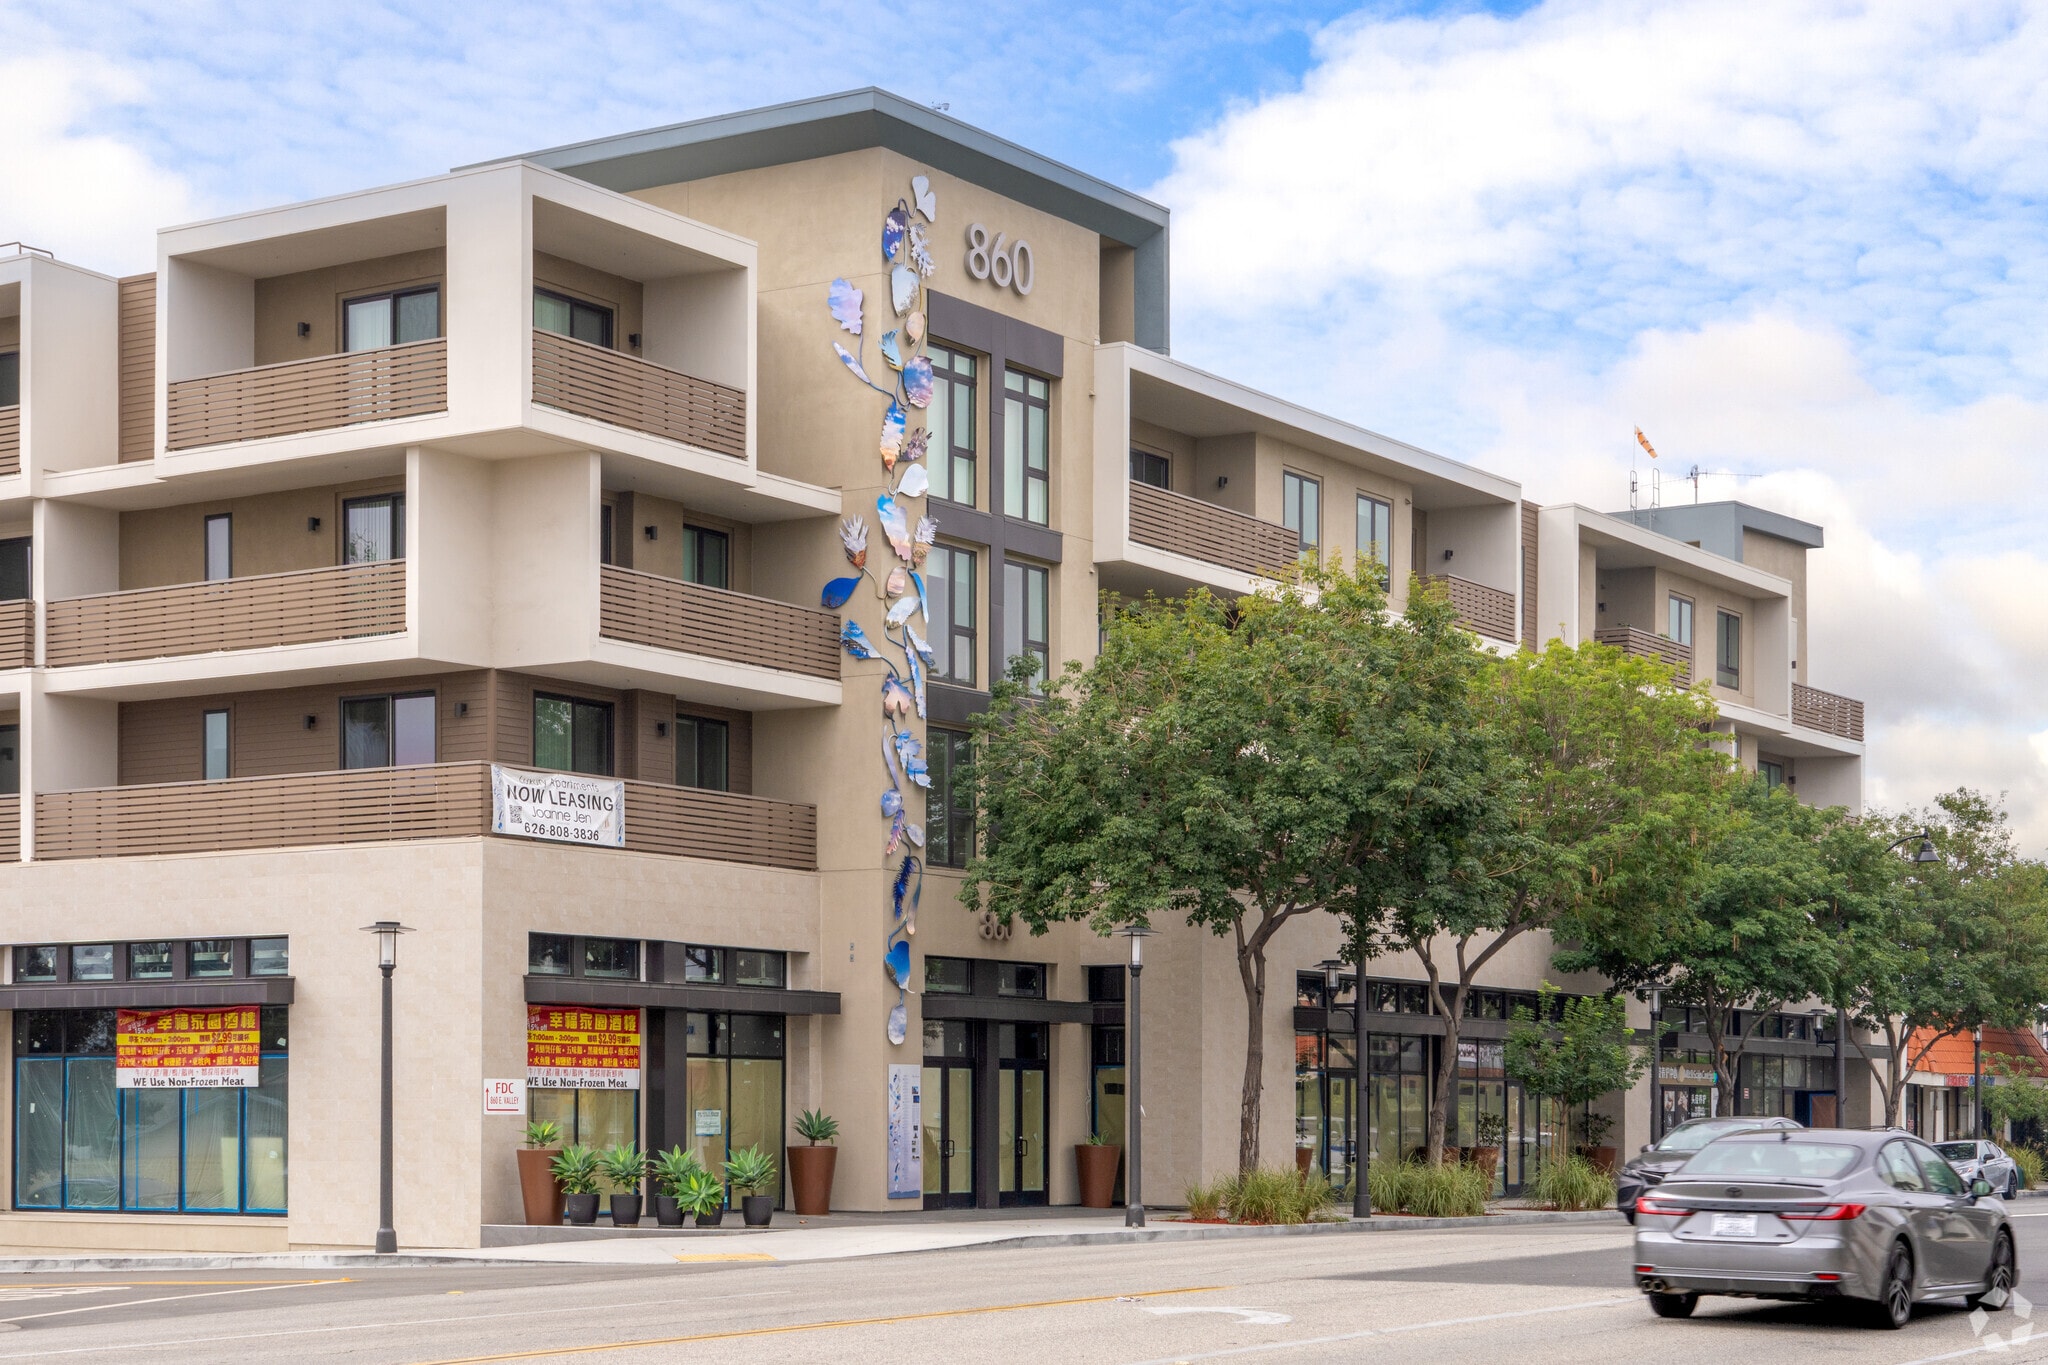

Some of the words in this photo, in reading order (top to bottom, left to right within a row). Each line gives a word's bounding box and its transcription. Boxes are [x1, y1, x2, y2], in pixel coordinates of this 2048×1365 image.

[964, 223, 1035, 297] 860
[550, 778, 599, 792] Apartments
[507, 785, 545, 804] NOW
[549, 790, 614, 812] LEASING
[532, 806, 571, 822] Joanne
[574, 810, 592, 824] Jen
[524, 822, 599, 841] 626-808-3836
[140, 1036, 162, 1044] 7:00am
[211, 1032, 232, 1044] $2.99
[533, 1033, 554, 1041] 7:00am
[559, 1034, 580, 1042] 3:00pm
[598, 1033, 617, 1045] $2.99
[133, 1077, 147, 1087] WE
[150, 1077, 165, 1087] Use
[168, 1077, 218, 1087] Non-Frozen
[221, 1077, 245, 1086] Meat
[495, 1082, 514, 1094] FDC
[542, 1077, 557, 1087] Use
[560, 1077, 605, 1088] Non-Frozen
[608, 1078, 628, 1088] Meat
[504, 1096, 519, 1105] VALLEY
